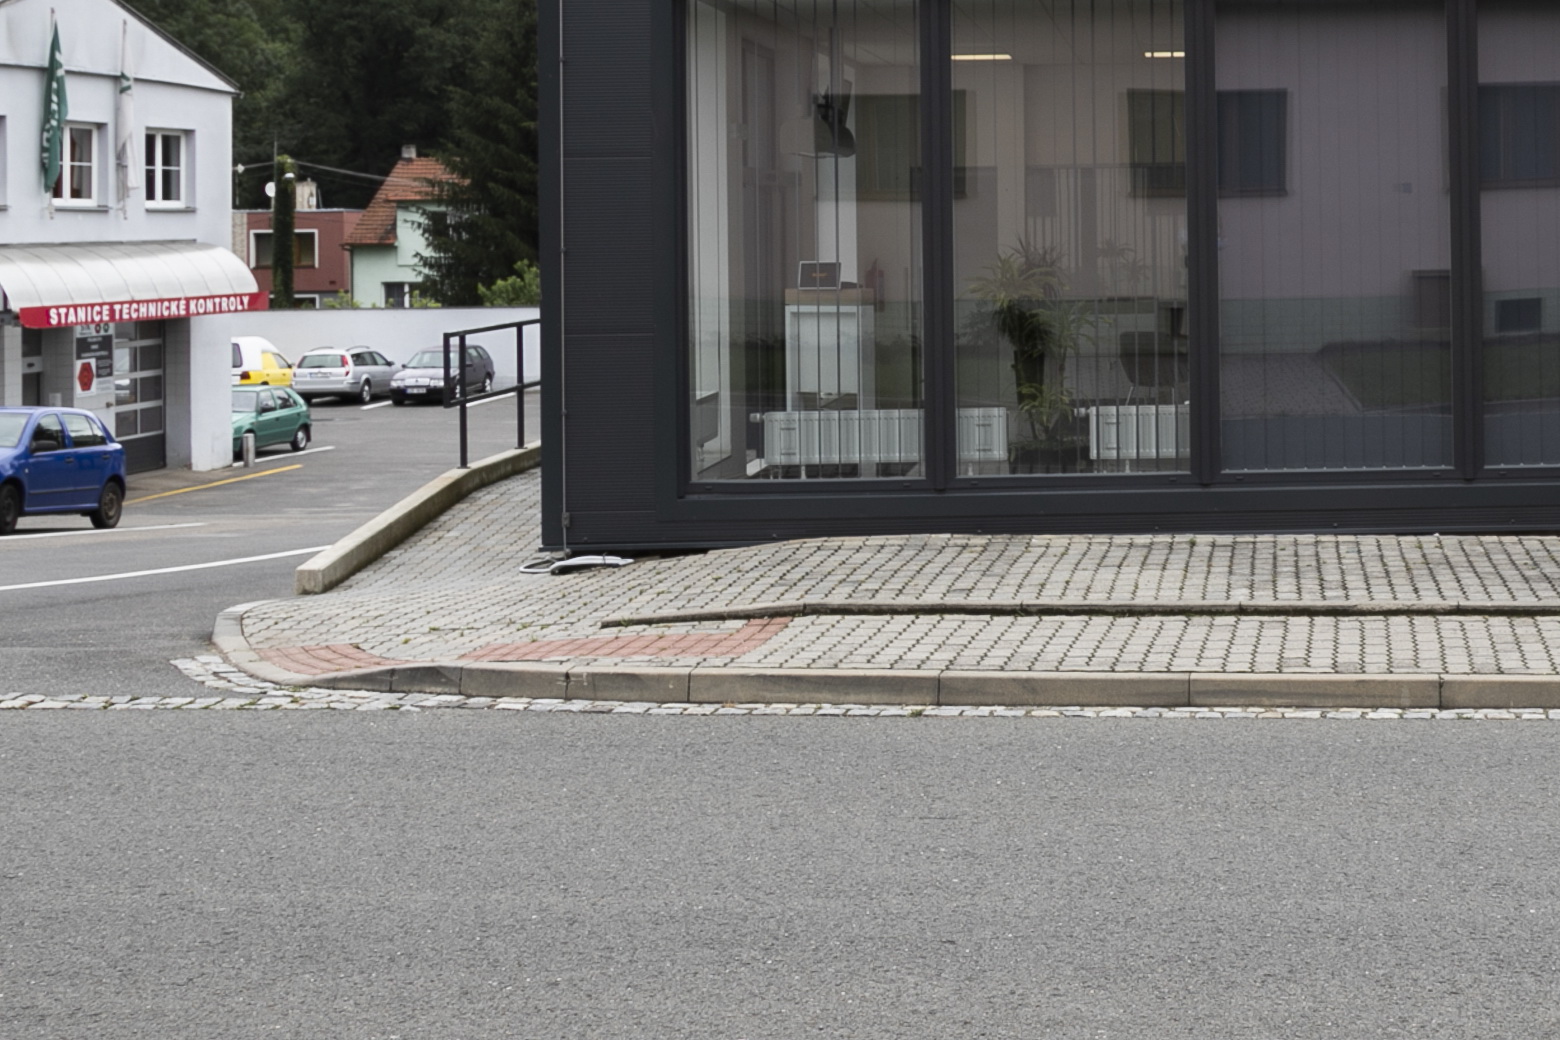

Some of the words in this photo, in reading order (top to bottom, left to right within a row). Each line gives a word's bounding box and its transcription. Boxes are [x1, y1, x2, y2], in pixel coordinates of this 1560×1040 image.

[49, 304, 110, 326] STANICE
[113, 297, 187, 321] TECHNICKÉ
[189, 295, 250, 315] KONTROLY
